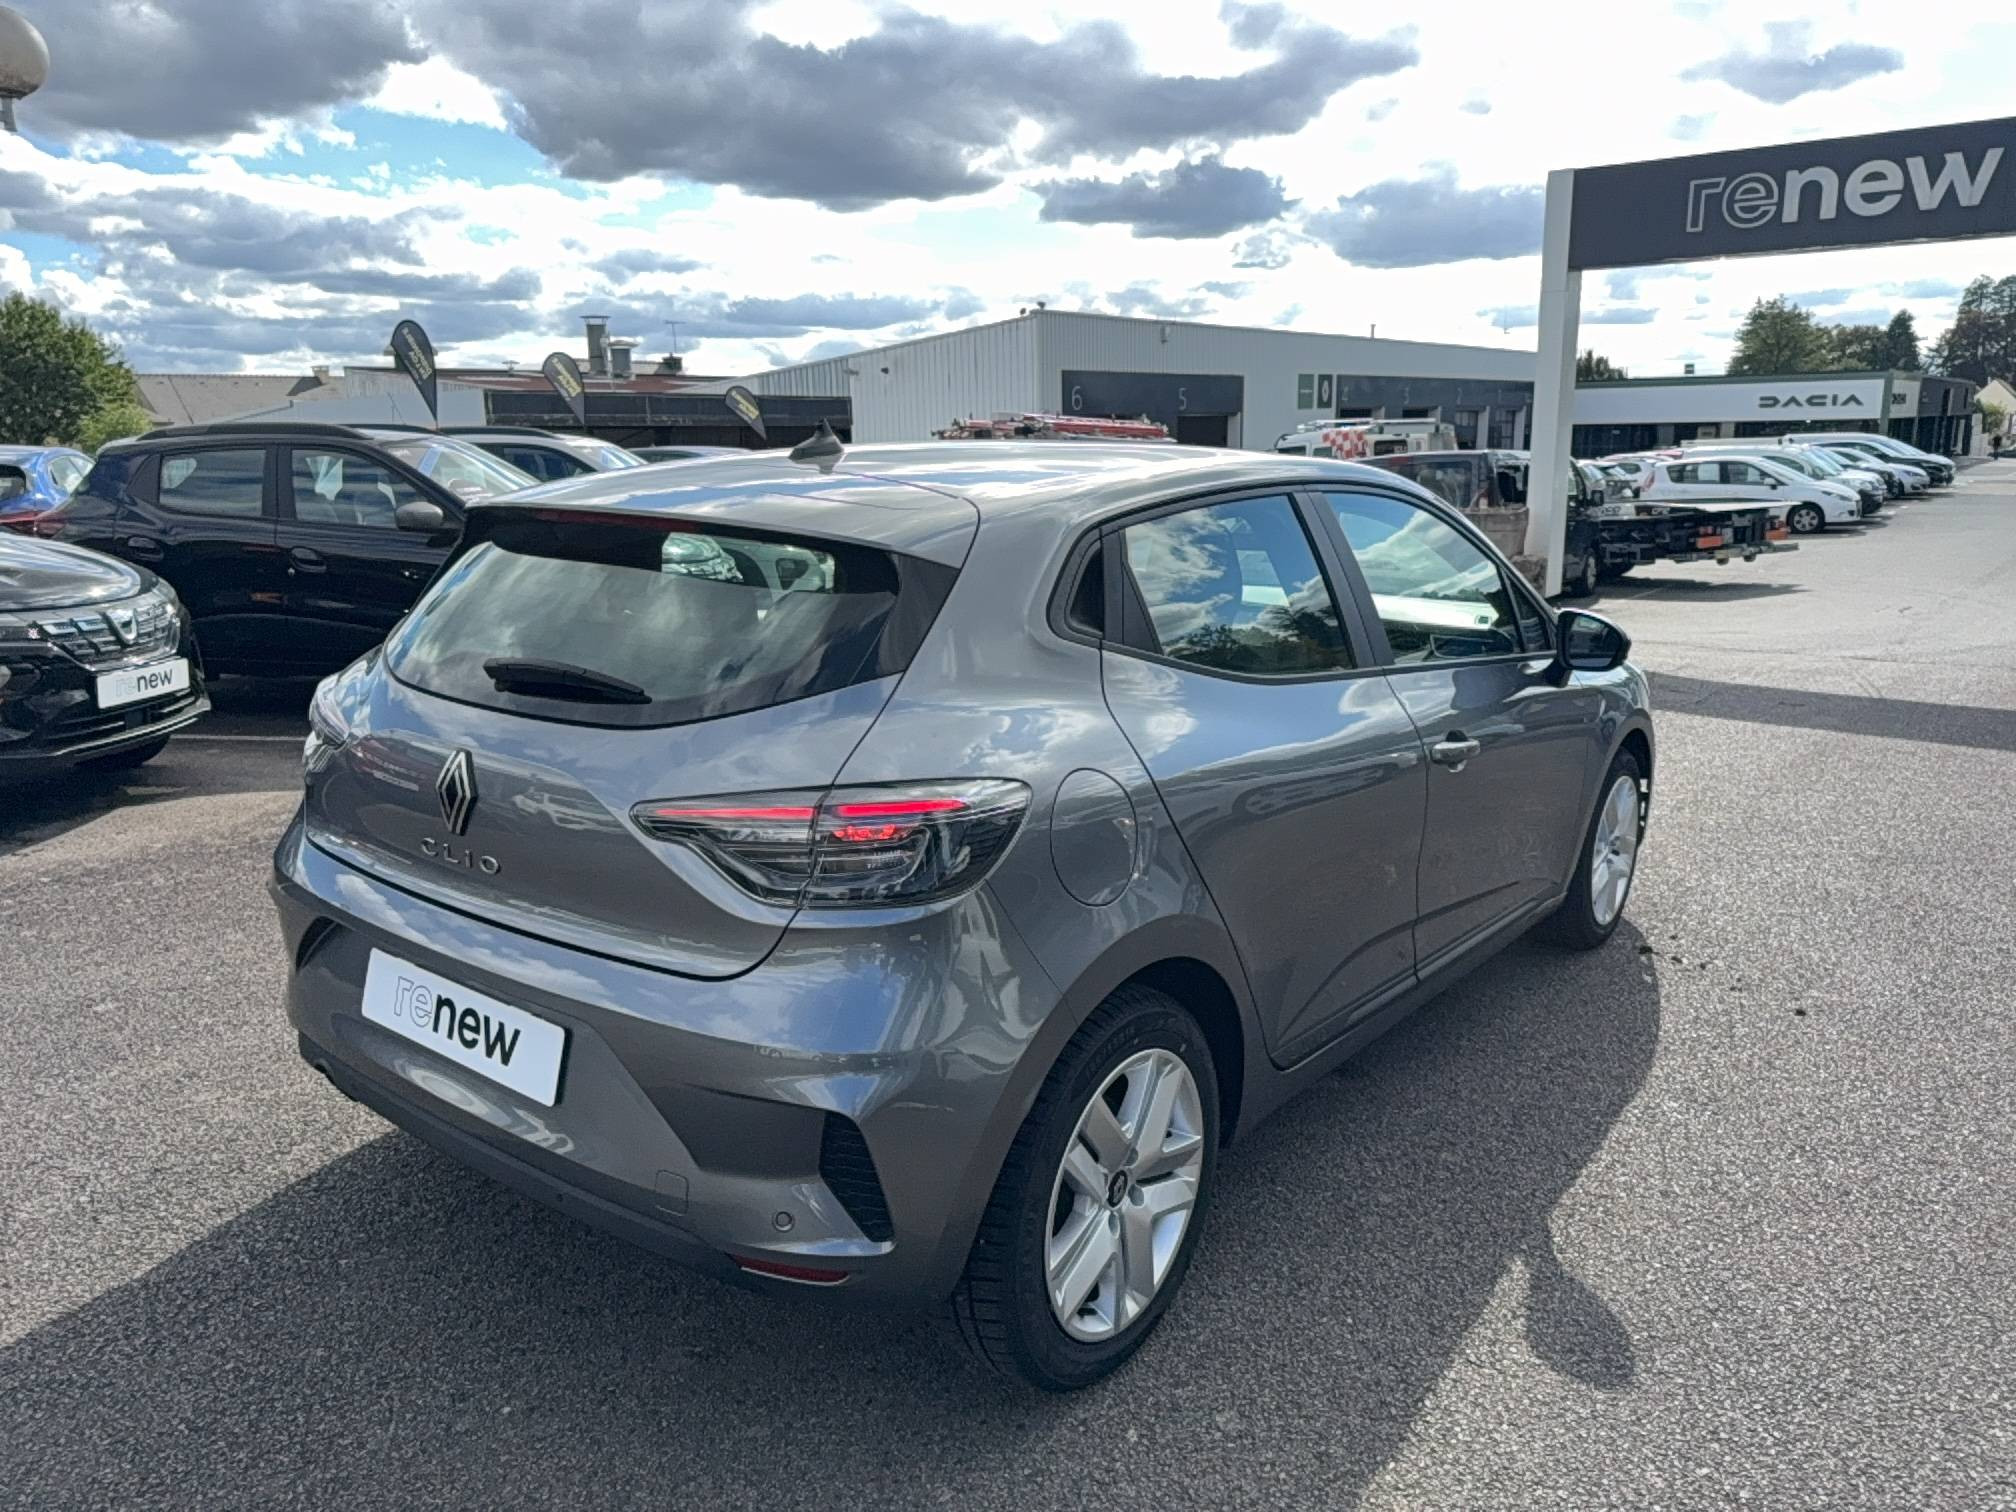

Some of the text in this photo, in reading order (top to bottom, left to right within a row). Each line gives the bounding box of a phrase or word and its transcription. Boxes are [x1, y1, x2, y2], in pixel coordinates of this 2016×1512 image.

[1686, 147, 2005, 232] renew
[1071, 386, 1083, 411] 6
[1178, 388, 1188, 410] 5
[1758, 393, 1864, 408] DACIA
[421, 837, 501, 875] CLIO
[393, 976, 521, 1067] renew
